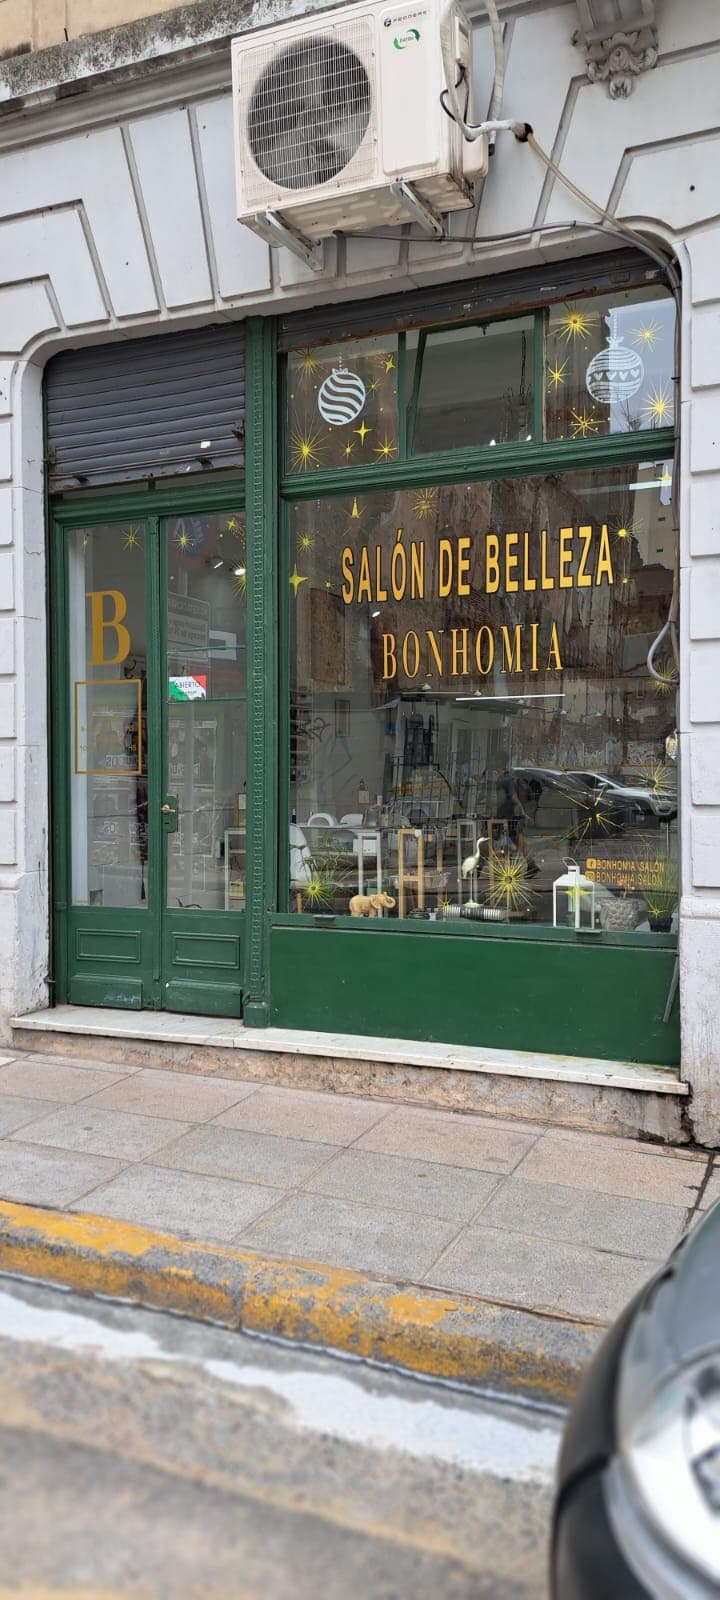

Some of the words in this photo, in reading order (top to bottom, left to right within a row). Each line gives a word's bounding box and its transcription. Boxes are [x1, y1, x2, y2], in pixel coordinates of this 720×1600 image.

[340, 528, 425, 605] SALÓN
[438, 537, 472, 598] DE
[485, 524, 614, 595] BELLEZA
[86, 590, 131, 666] B
[381, 621, 564, 680] BONHOMIA
[597, 860, 635, 871] BONHOMIA
[640, 860, 664, 872] SALÓN
